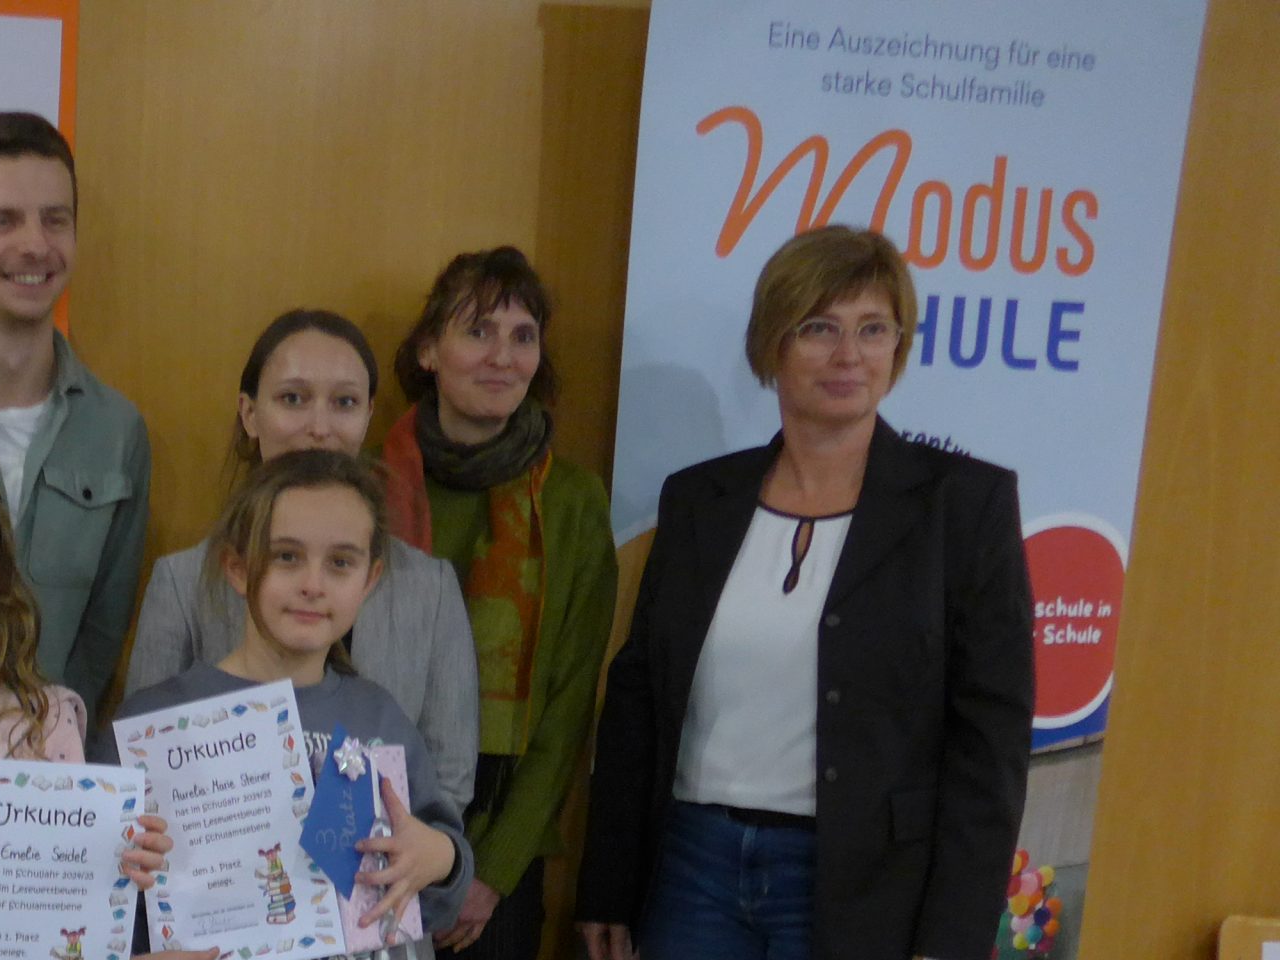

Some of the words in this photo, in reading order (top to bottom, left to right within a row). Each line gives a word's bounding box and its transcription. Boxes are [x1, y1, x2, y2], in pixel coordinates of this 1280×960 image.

[768, 21, 820, 50] Eine
[828, 26, 1000, 71] Auszeichnung
[1008, 39, 1040, 66] für
[1046, 46, 1096, 72] eine
[821, 71, 892, 97] starke
[900, 73, 1045, 107] Schulfamilie
[695, 105, 1099, 278] Modus
[1097, 600, 1112, 617] in
[1042, 624, 1102, 645] Schule
[168, 731, 257, 770] Urkunde
[51, 845, 89, 863] Seidel
